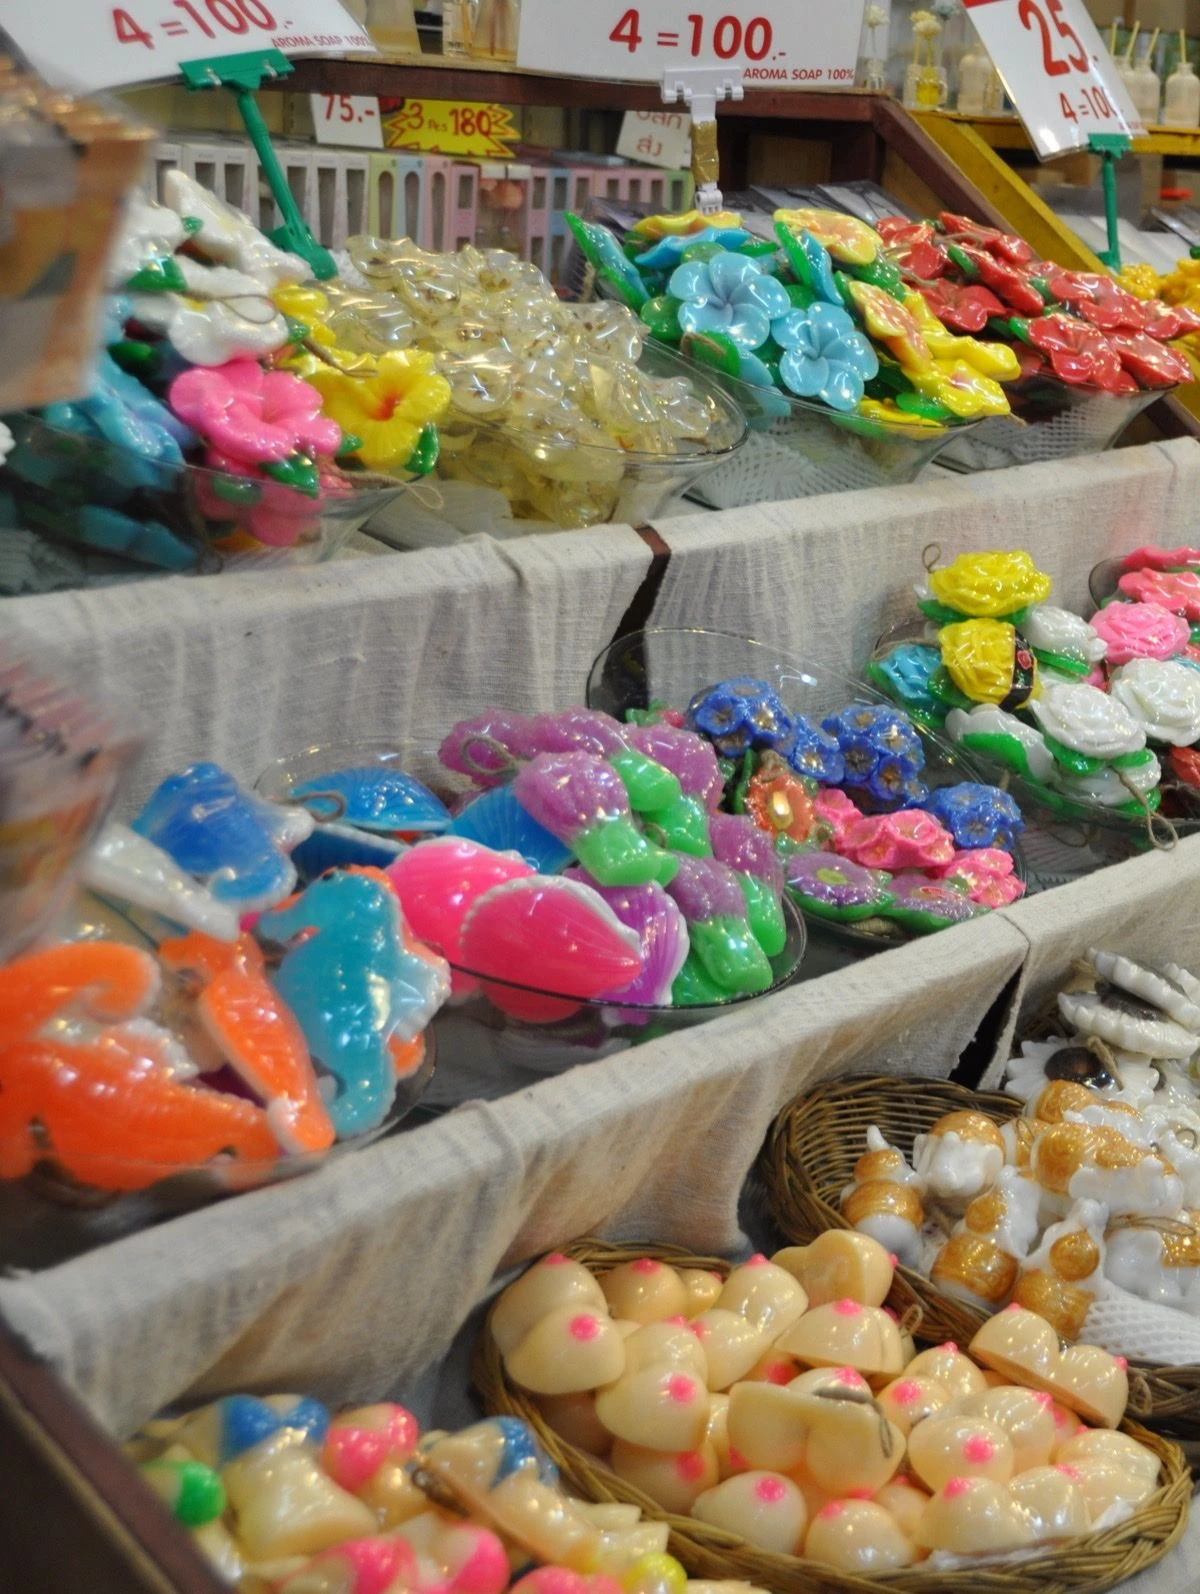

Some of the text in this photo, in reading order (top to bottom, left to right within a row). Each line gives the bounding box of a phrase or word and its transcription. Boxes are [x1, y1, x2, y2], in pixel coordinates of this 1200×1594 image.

[271, 36, 314, 48] AROMA
[313, 35, 343, 47] SOAP
[743, 68, 856, 80] AROMA SOAP 100%
[407, 102, 425, 130] 3
[449, 108, 492, 137] 180
